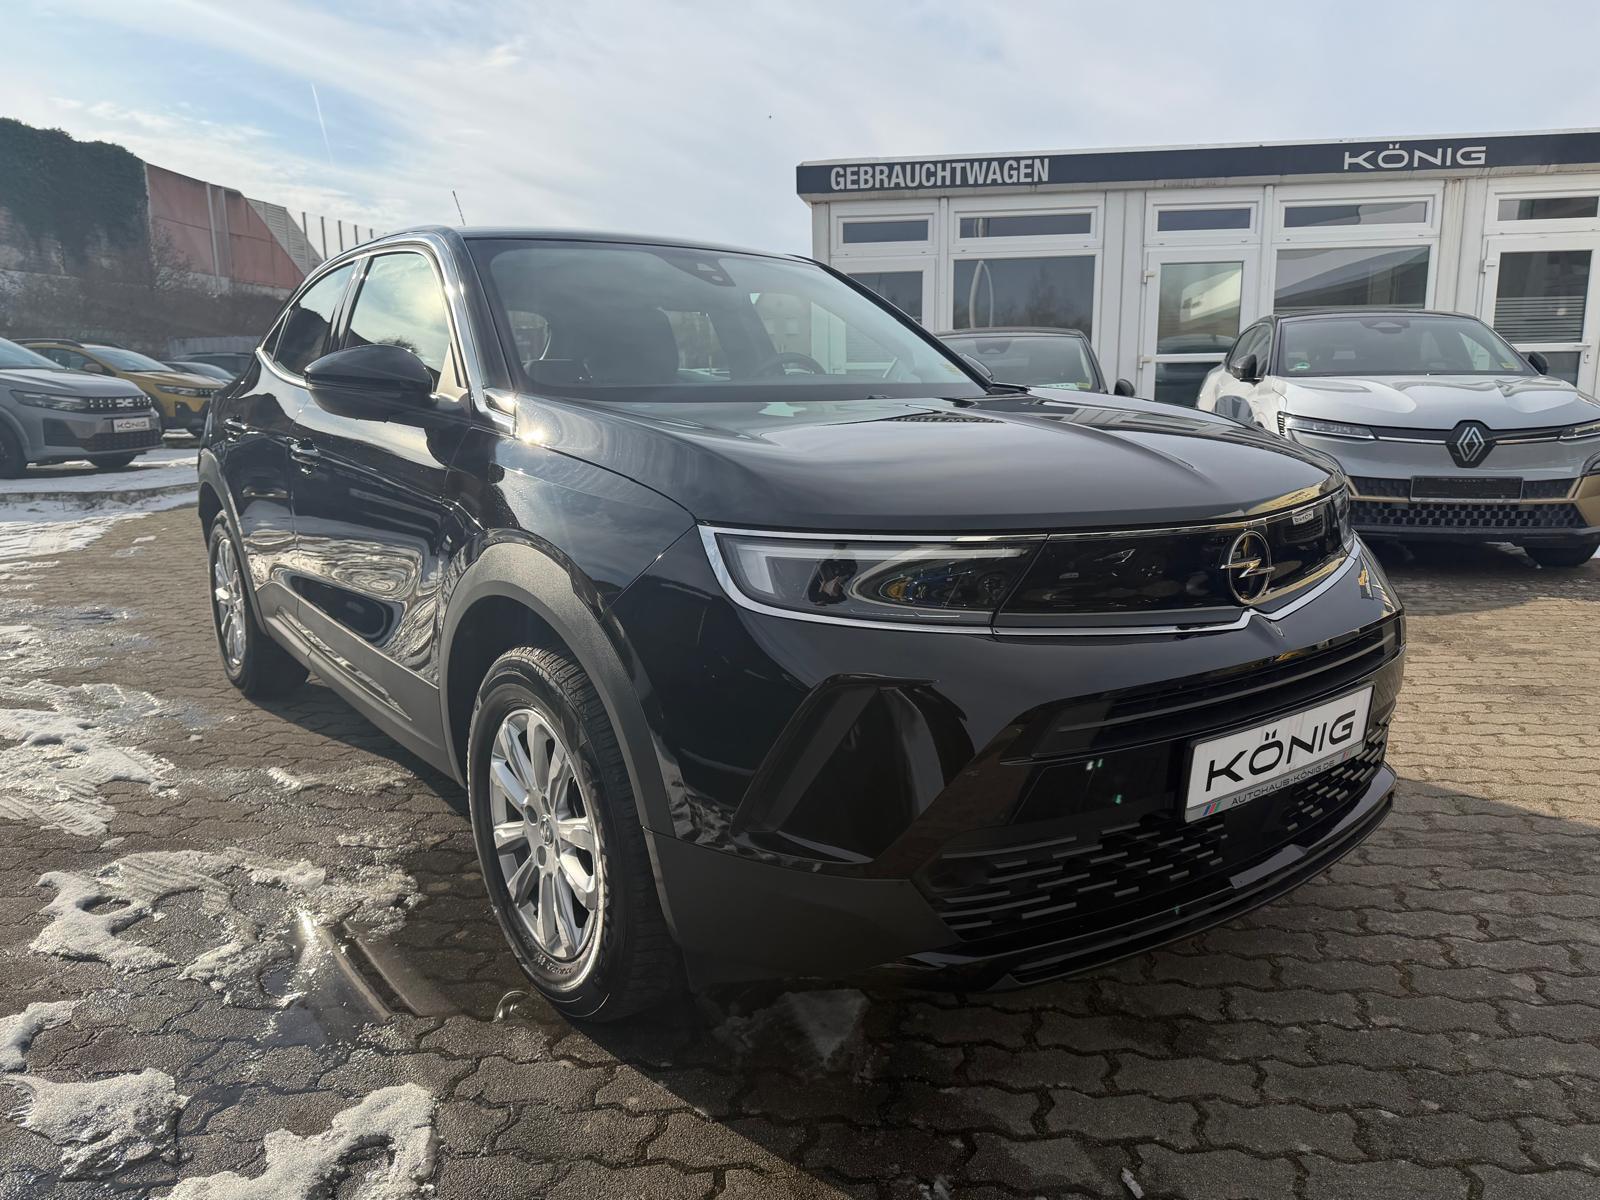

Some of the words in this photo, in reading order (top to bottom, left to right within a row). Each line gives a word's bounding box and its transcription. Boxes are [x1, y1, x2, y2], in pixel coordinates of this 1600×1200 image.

[1343, 143, 1487, 170] KÖNIG
[831, 158, 1049, 190] GEBRAUCHTWAGEN
[1206, 709, 1356, 792] KÖNIG
